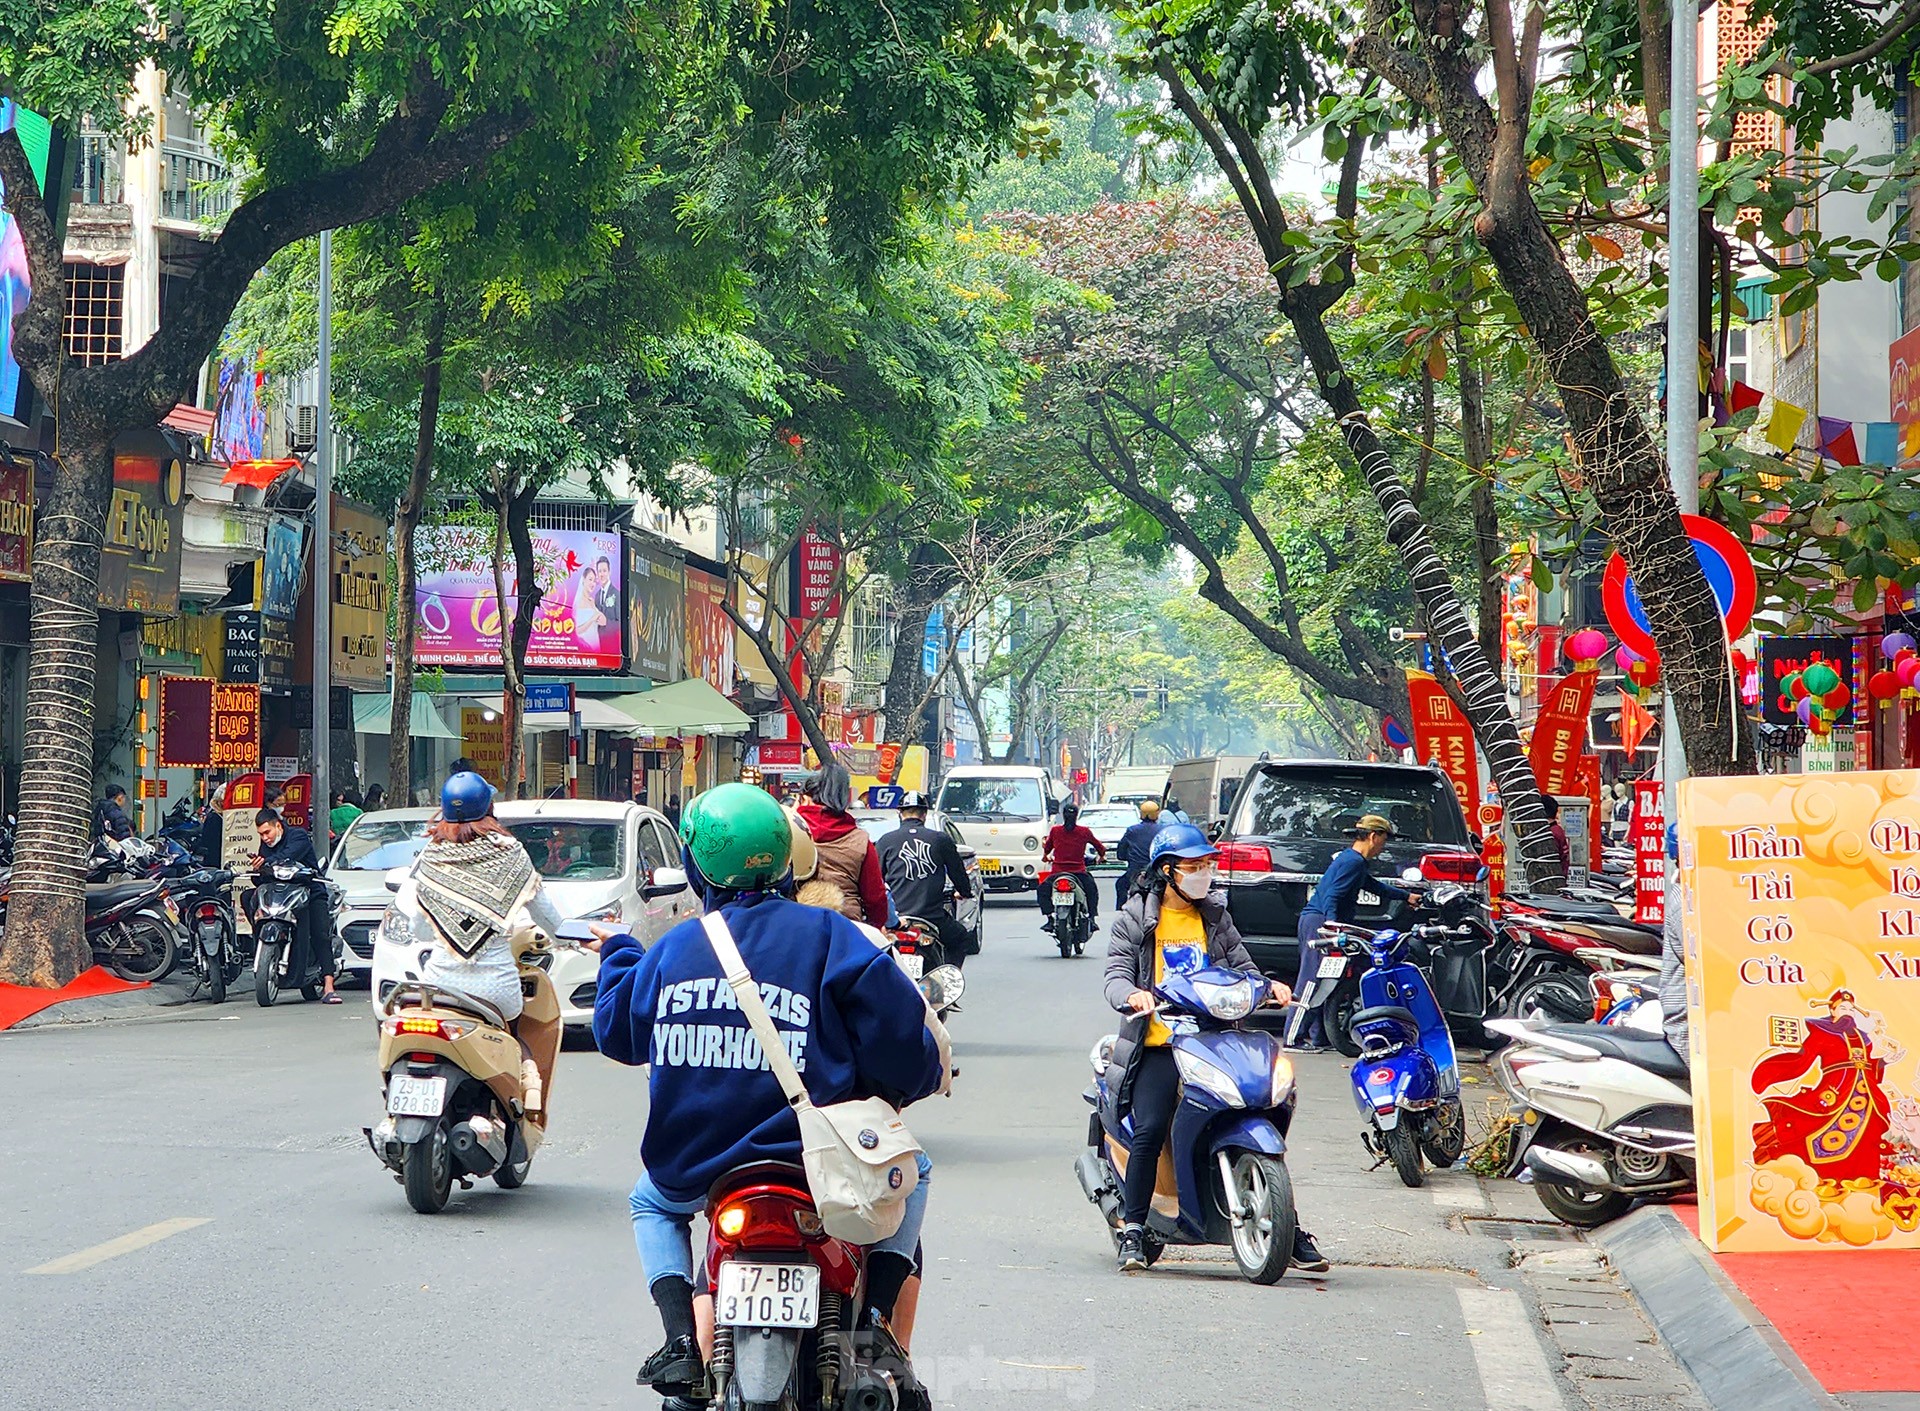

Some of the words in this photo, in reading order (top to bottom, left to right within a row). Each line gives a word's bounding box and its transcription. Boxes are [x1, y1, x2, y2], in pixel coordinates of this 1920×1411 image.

[810, 545, 830, 557] TÂM
[807, 558, 833, 571] VÀNG
[811, 574, 830, 586] BẠC
[805, 587, 835, 598] TRAN
[228, 628, 256, 645] BẠC
[226, 648, 258, 658] TRANG
[420, 654, 441, 663] MINH
[443, 653, 467, 663] CHÂU
[474, 652, 489, 663] THẾ
[232, 664, 250, 673] SỨC
[215, 688, 254, 712] VÀNG
[219, 716, 249, 739] BẠC
[214, 742, 255, 762] 9999
[1447, 736, 1466, 775] KIM
[1552, 728, 1572, 764] BẢO
[1808, 759, 1833, 771] BÌNH
[1547, 767, 1567, 794] TÍN
[876, 788, 895, 806] G7
[286, 816, 304, 826] OLD
[229, 835, 253, 843] TRUNG
[1723, 824, 1804, 860] Thần
[1741, 871, 1795, 902] Tài
[1747, 914, 1794, 944] Gõ
[1739, 955, 1806, 986] Cửa
[391, 1095, 439, 1114] 828.68
[738, 1266, 804, 1293] 17-B6
[724, 1295, 811, 1323] 310.54
